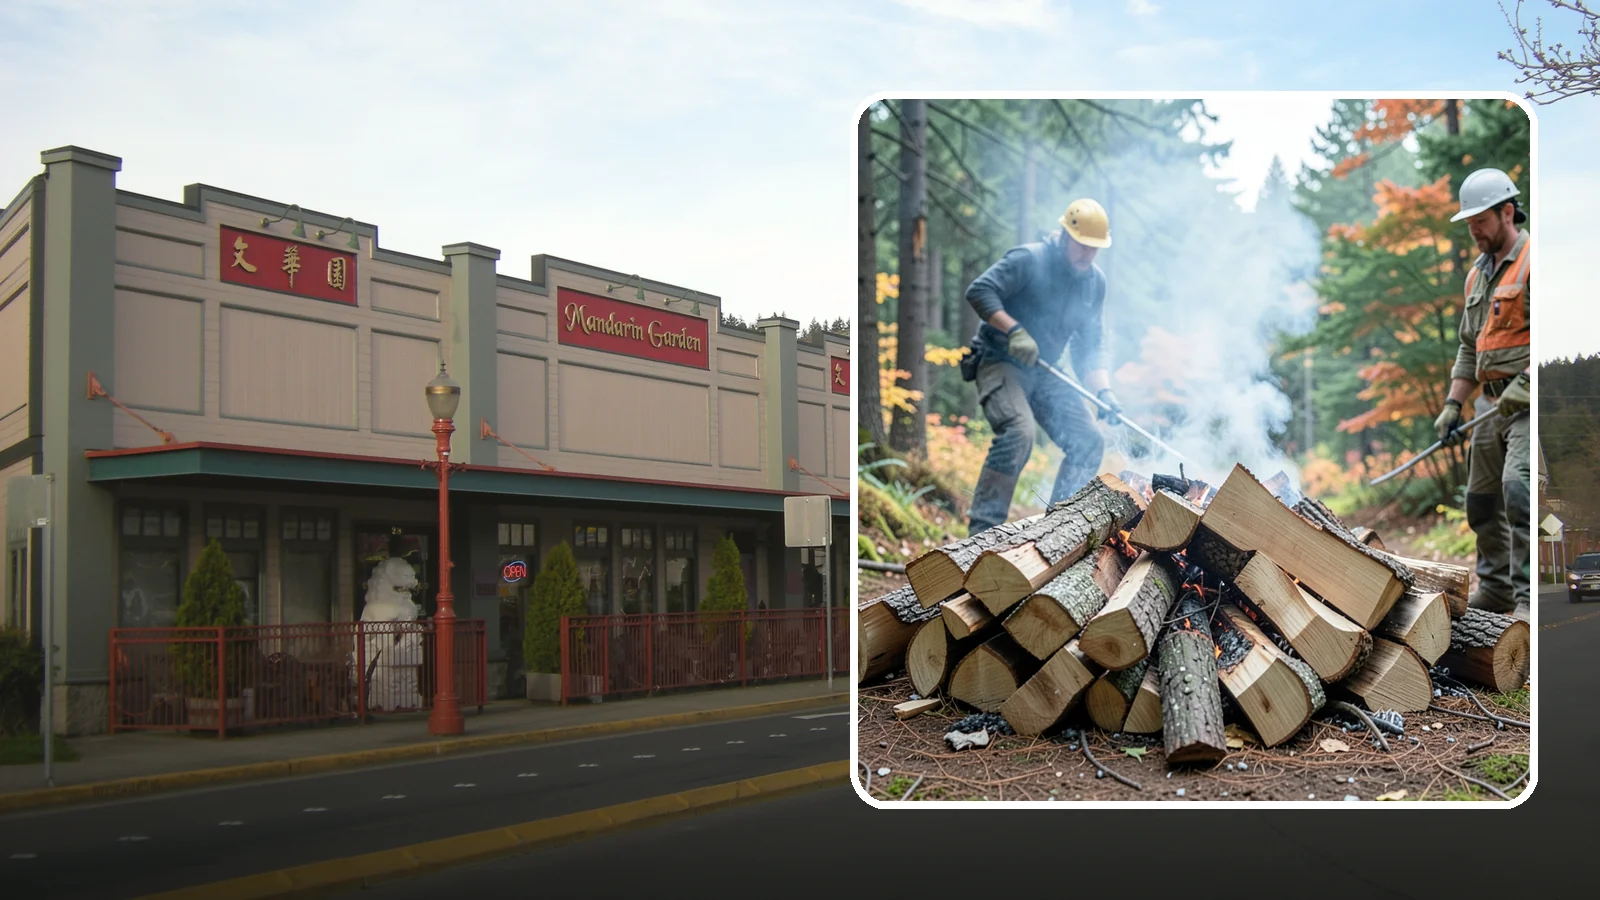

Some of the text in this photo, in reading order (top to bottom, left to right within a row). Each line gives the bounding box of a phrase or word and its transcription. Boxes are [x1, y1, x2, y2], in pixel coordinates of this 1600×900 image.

[231, 235, 346, 291] 文華園
[564, 302, 702, 352] Mandarin Garden
[503, 565, 527, 578] OPEN
